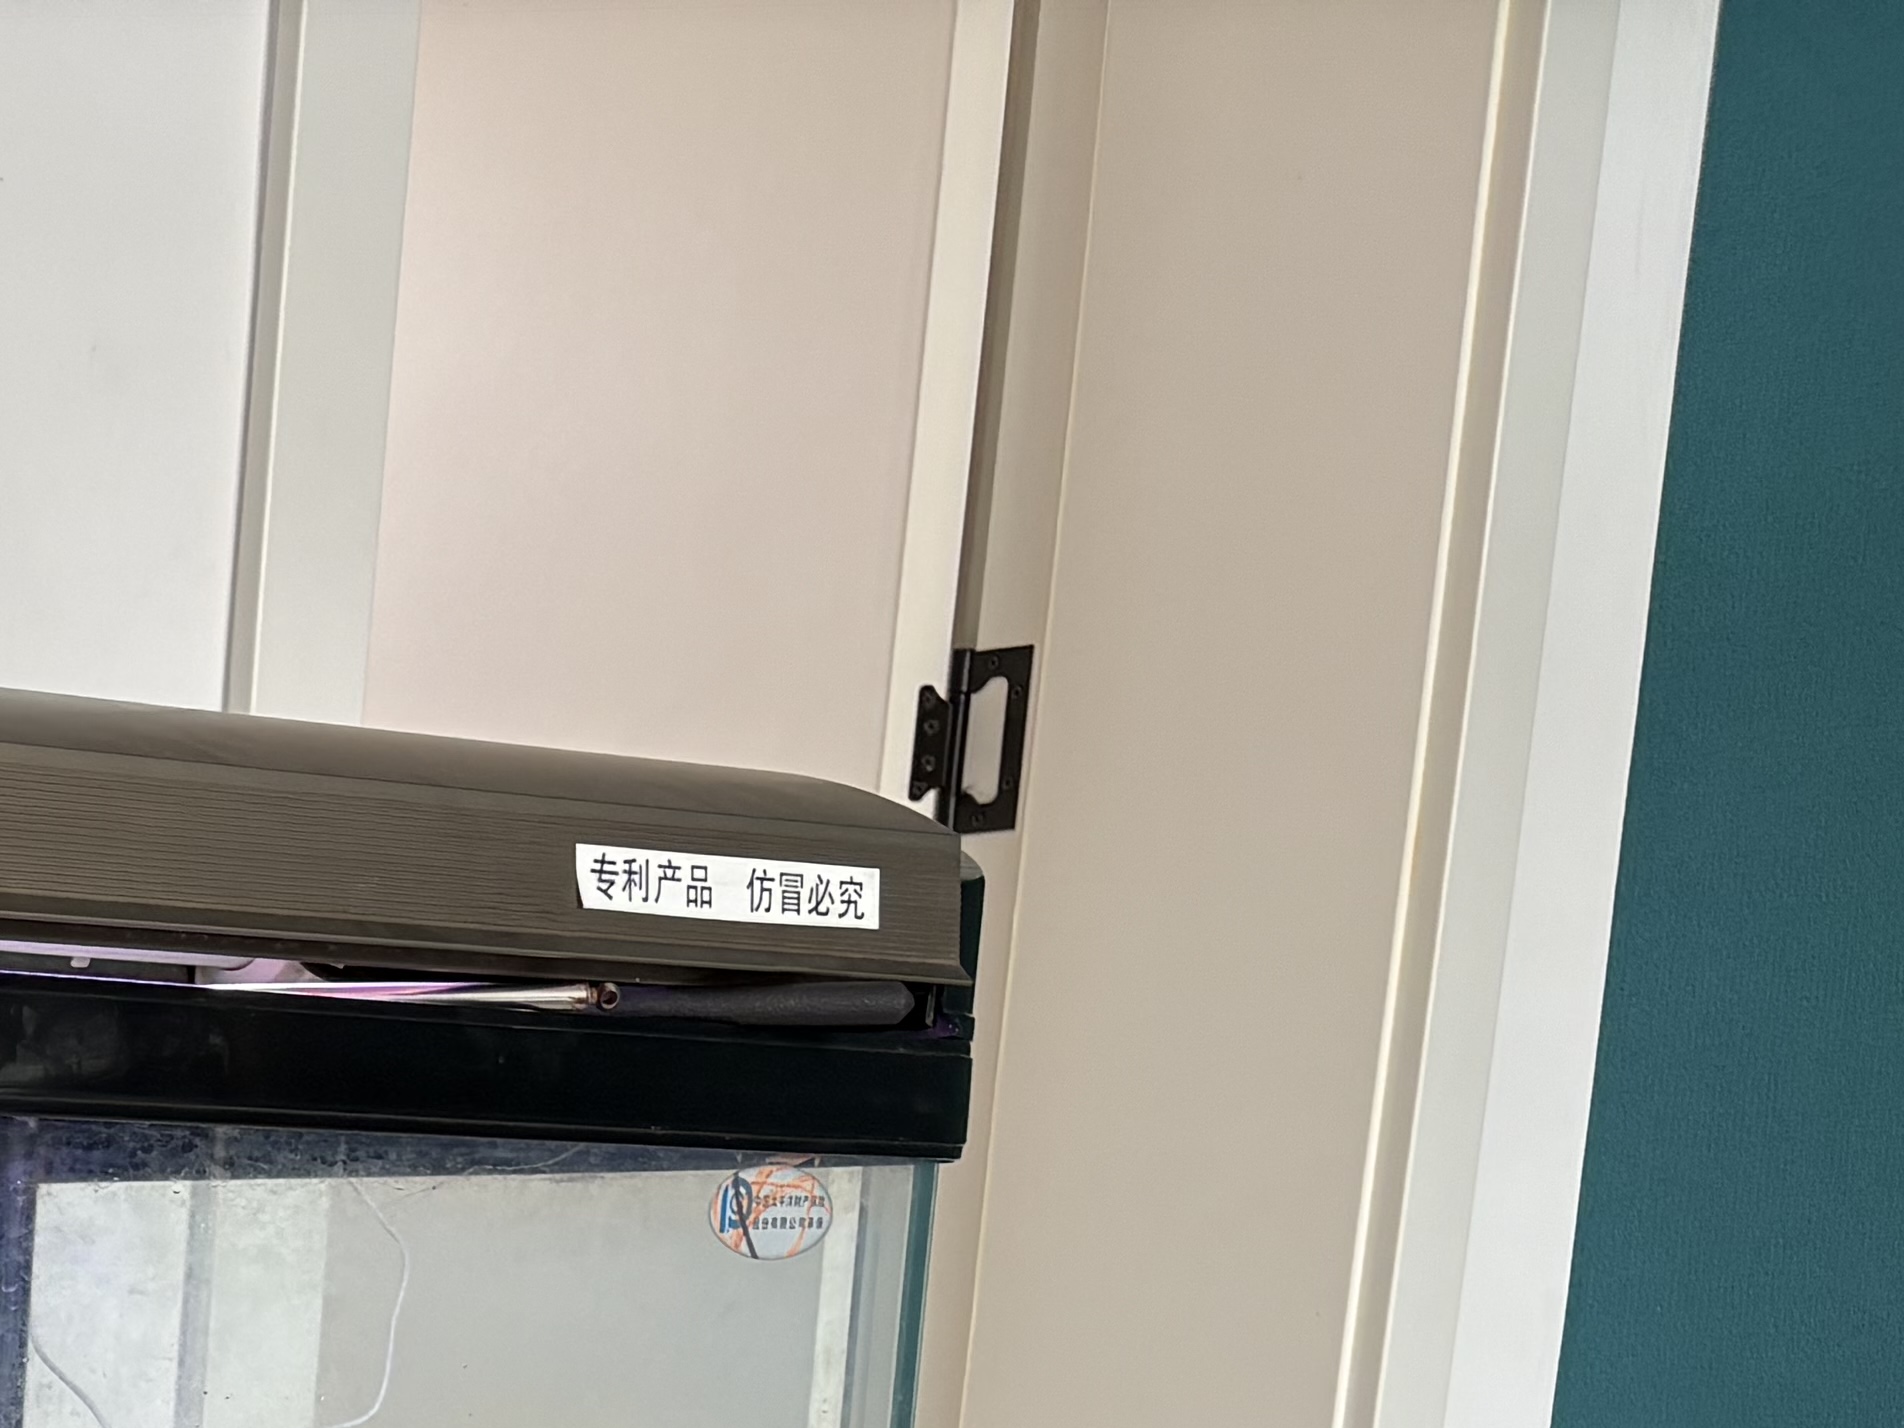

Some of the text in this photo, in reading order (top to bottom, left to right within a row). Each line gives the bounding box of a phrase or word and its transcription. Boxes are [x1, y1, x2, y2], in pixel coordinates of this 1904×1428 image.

[590, 851, 865, 921] 专利产品 仿冒必究
